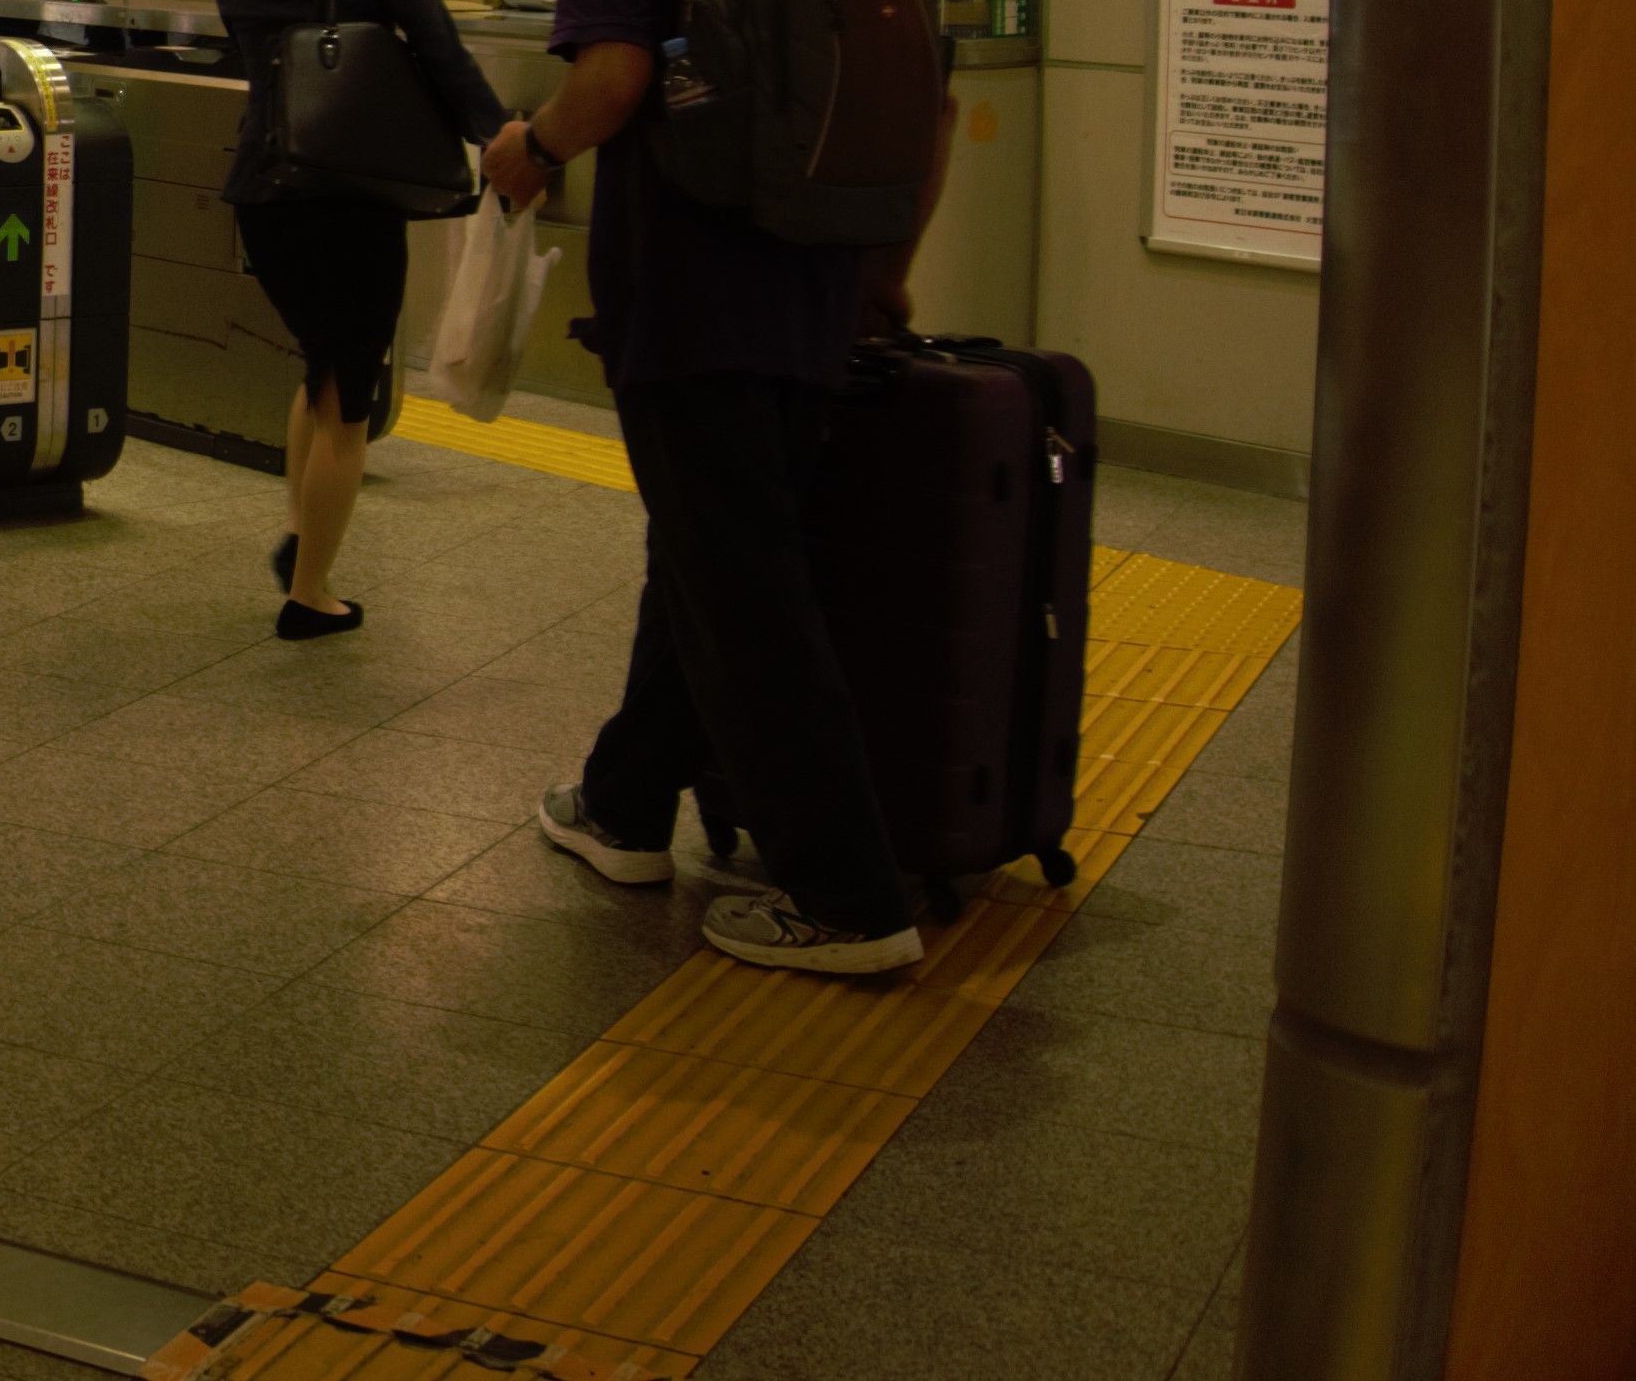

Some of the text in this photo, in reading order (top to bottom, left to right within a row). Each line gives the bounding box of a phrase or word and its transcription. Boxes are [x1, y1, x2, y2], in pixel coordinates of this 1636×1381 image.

[60, 135, 70, 181] ここは
[45, 151, 59, 245] 在来線改札口
[8, 422, 16, 436] 2
[94, 414, 100, 428] 1
